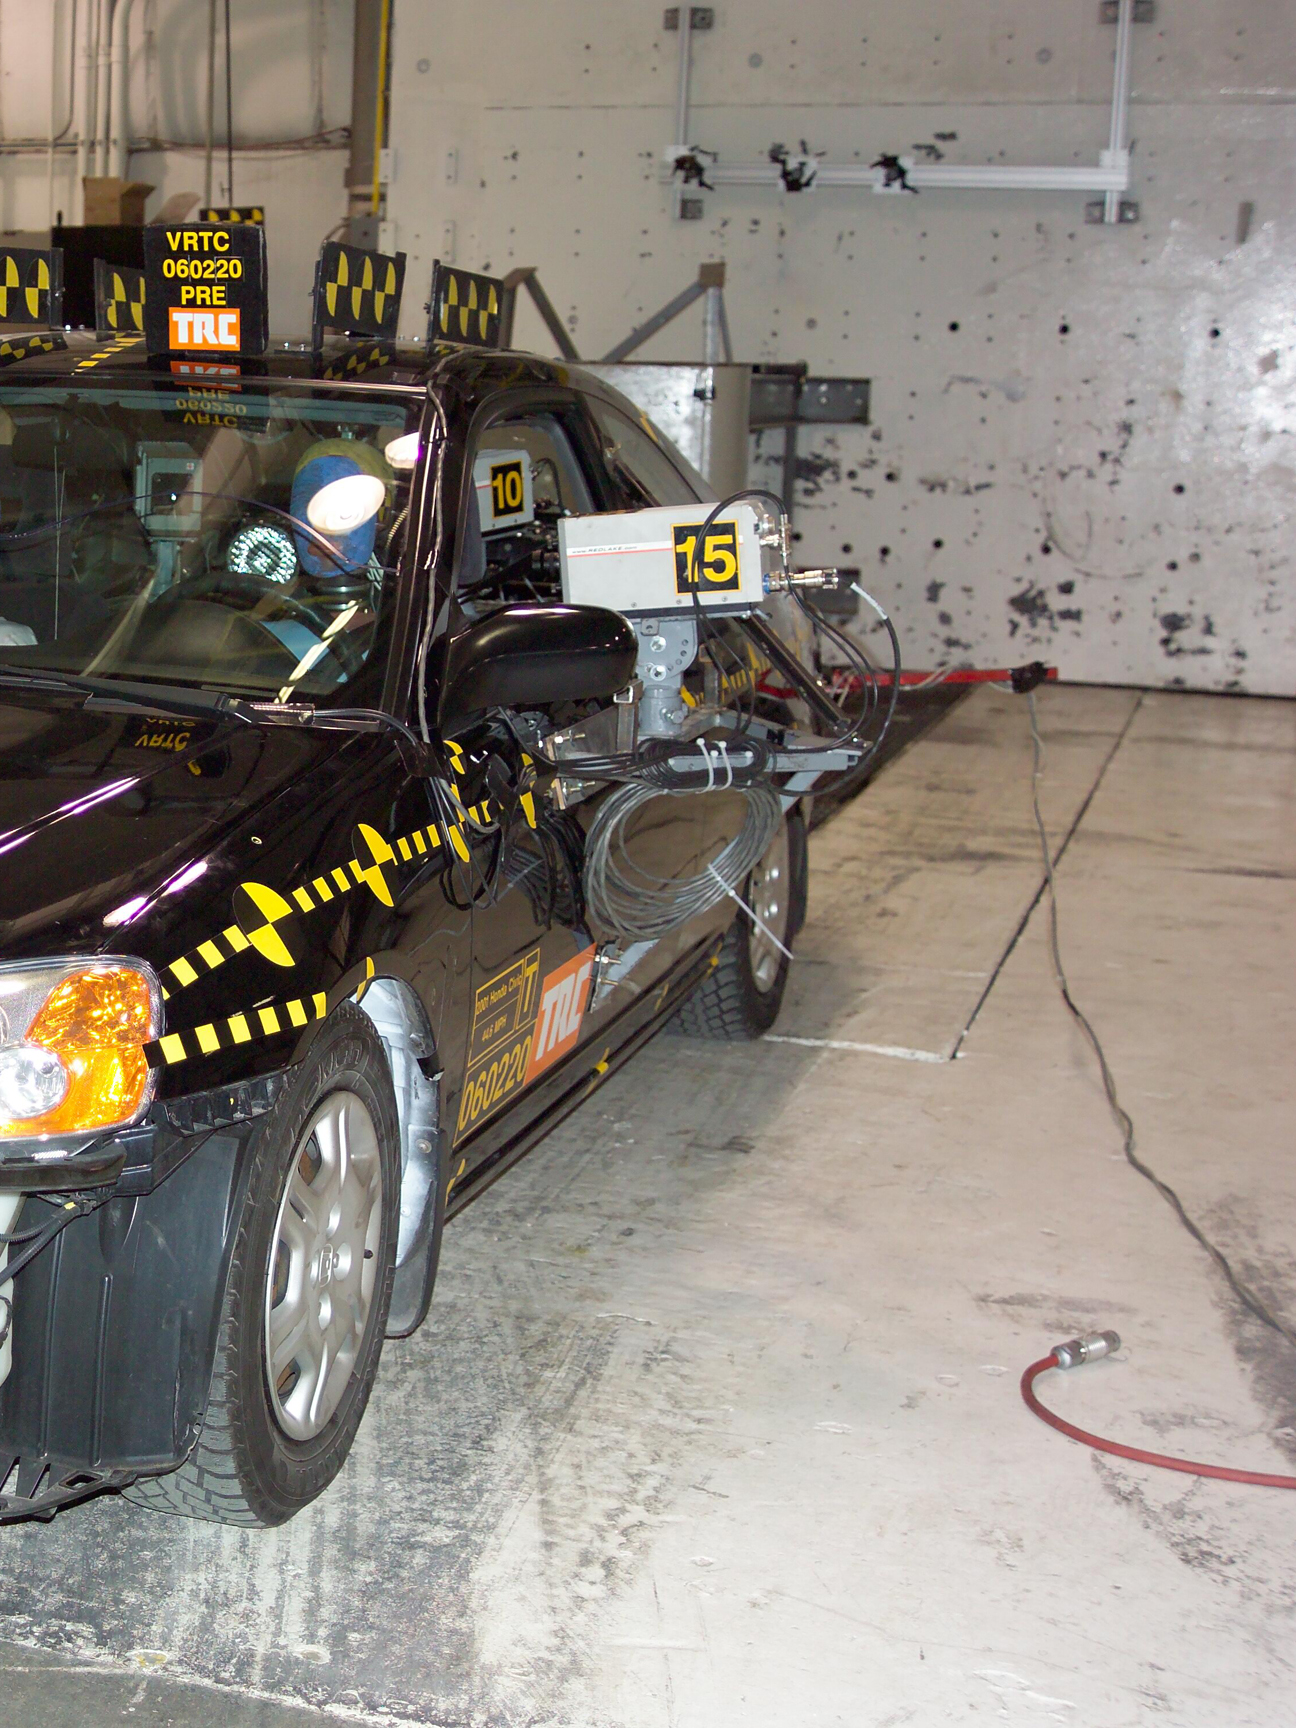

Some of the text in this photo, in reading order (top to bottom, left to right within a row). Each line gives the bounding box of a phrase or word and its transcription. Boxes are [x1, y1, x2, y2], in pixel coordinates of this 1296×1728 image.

[166, 231, 230, 251] VRTC
[163, 259, 242, 279] 060220
[181, 286, 227, 305] PRE
[172, 312, 237, 345] TRC
[491, 470, 522, 508] 10
[675, 534, 737, 584] 15
[490, 984, 507, 1006] Honda
[523, 961, 538, 1013] T
[494, 1014, 507, 1033] MPH
[535, 961, 592, 1061] TRC
[459, 1035, 532, 1131] 060220
